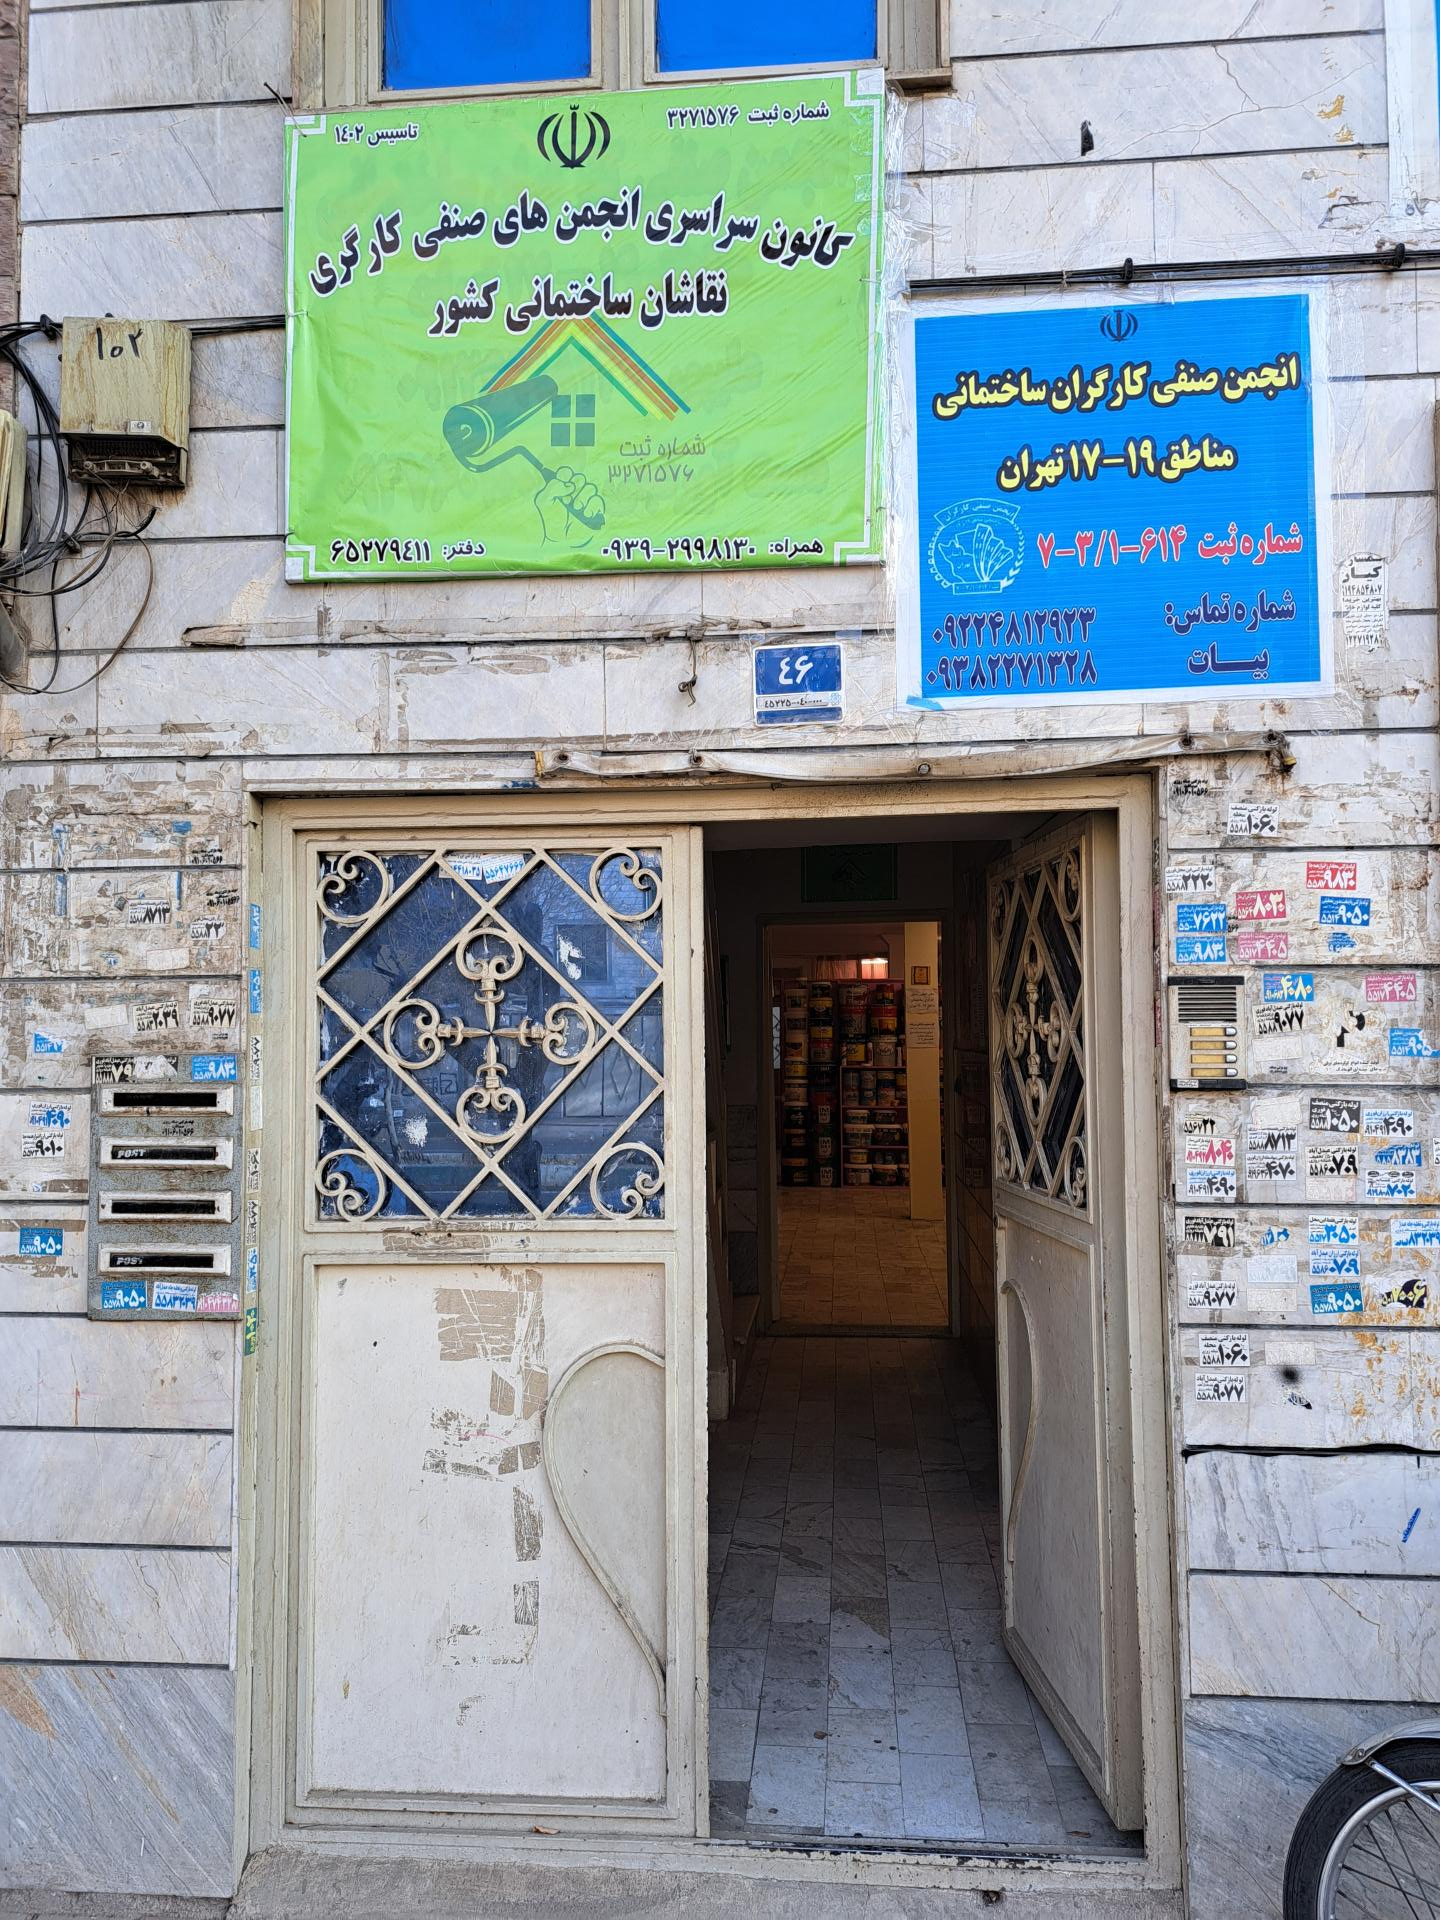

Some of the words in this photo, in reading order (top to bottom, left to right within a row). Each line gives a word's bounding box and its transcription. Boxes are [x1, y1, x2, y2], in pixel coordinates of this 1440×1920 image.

[666, 106, 740, 129] ۳۲۷۱۵۷۶
[748, 104, 779, 127] ثبت
[783, 101, 831, 124] شماره
[367, 122, 419, 147] تاسیس
[413, 202, 487, 261] صنفی
[493, 188, 549, 247] های
[554, 186, 641, 242] انجمن
[646, 190, 759, 252] سراسری
[760, 217, 854, 269] کانون
[427, 277, 500, 337] کشور
[505, 272, 633, 333] ساختمانی
[638, 268, 729, 331] نقاشان
[933, 367, 1049, 421] ساختمانی
[1051, 361, 1149, 413] کارگران
[1149, 359, 1220, 408] صنفی
[1220, 352, 1299, 403] انجمن
[620, 435, 651, 461] ثبت
[657, 433, 706, 460] شماره
[997, 444, 1066, 492] تهران
[1158, 433, 1238, 483] مناطق
[608, 464, 695, 483] ۳۲۷۱۵۷۶
[443, 540, 485, 561] دفتر:
[768, 537, 824, 559] همراه:
[1198, 522, 1240, 565] ثبت
[1241, 522, 1303, 565] شماره
[932, 607, 1097, 649] ۰۹۲۲۴۸۱۲۹۲۳
[1164, 593, 1231, 635] تماس:
[1233, 589, 1296, 632] شماره
[778, 655, 814, 685] ۴۶
[926, 649, 1098, 690] ۰۹۳۸۲۲۷۱۳۲۸
[117, 1149, 145, 1158] POST
[1202, 1343, 1248, 1365] ۵۵۸۸۱۰۶۰
[1197, 1384, 1243, 1402] ۵۵۸۸۹۰۷۷
